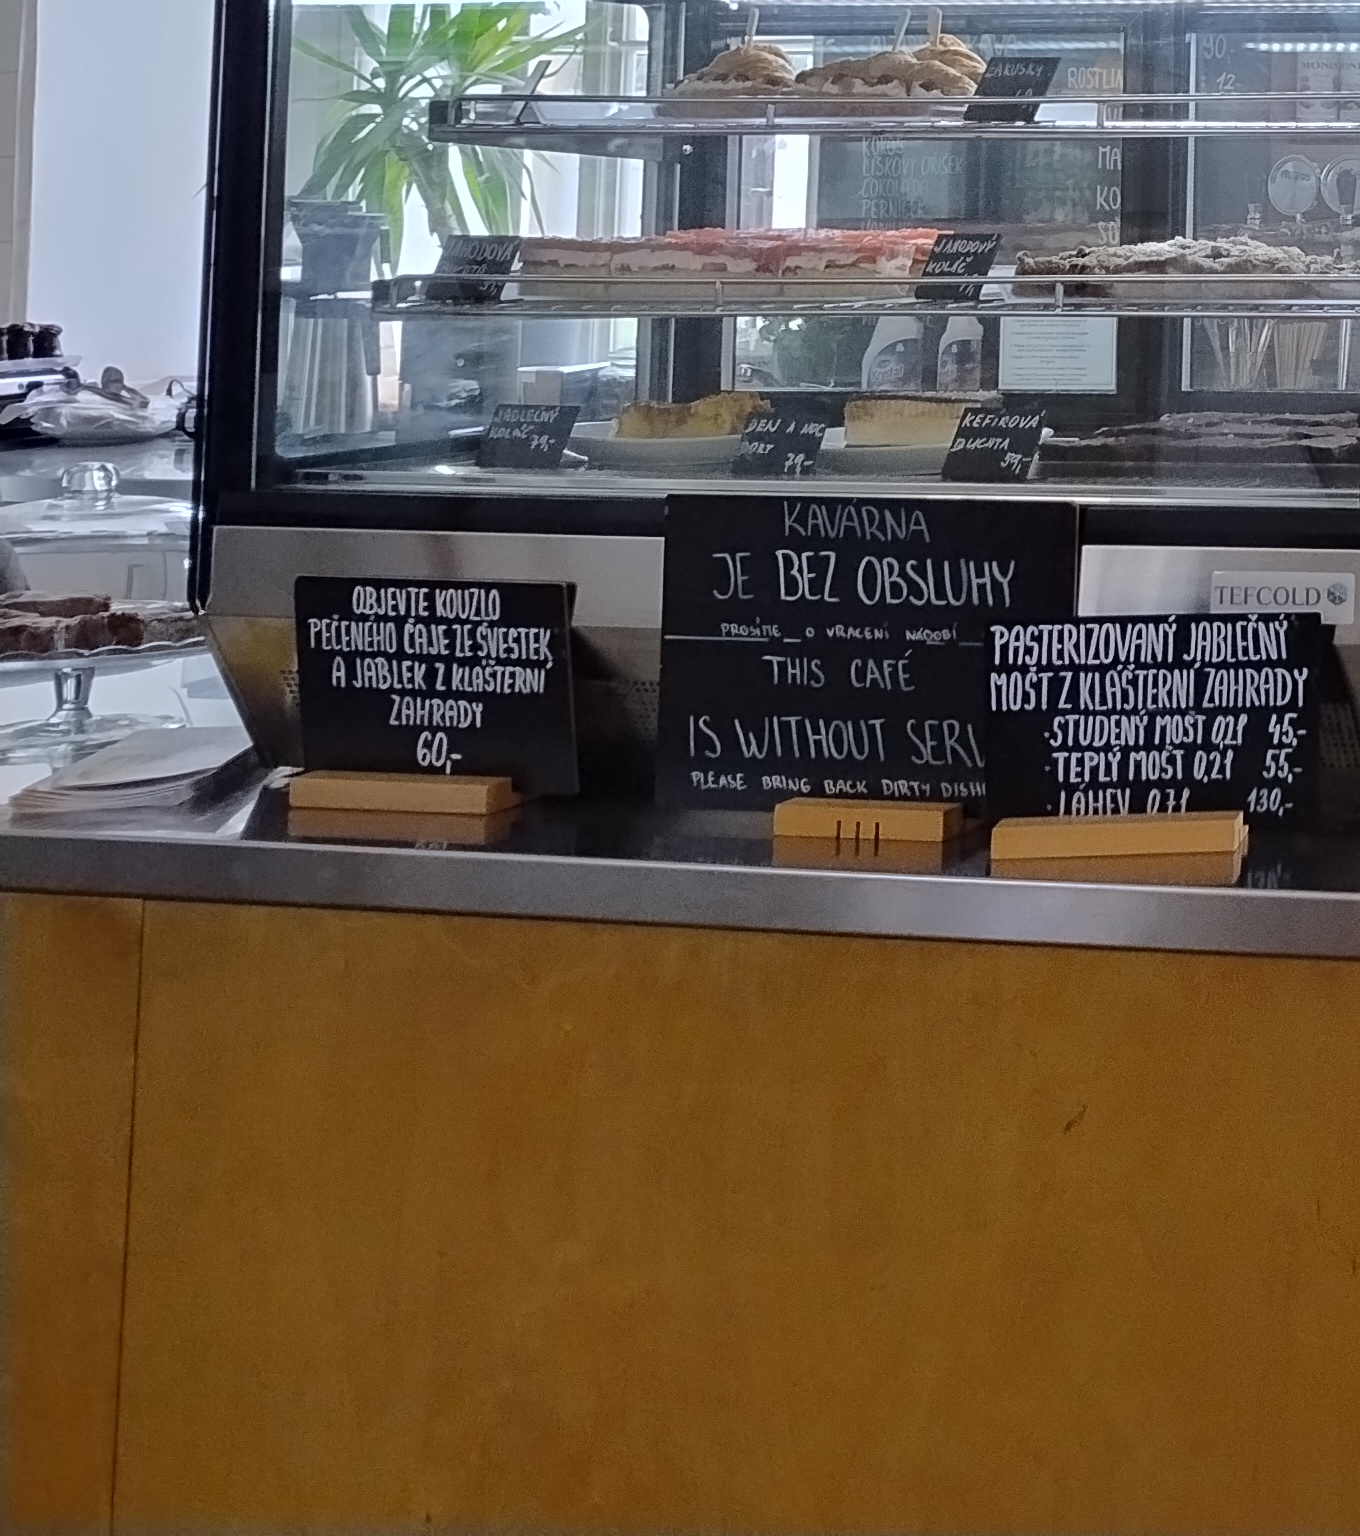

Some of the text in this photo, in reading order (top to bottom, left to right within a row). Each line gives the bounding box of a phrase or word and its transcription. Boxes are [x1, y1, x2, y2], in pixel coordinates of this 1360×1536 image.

[783, 498, 931, 542] KAVÁRNA
[713, 549, 1015, 607] JE BEZ OBSLUHY
[1215, 586, 1322, 606] TEFCOLD
[353, 586, 500, 620] OBJEVTE KOUZLO
[308, 615, 474, 657] PEČENÉHO ČAJE ZE
[806, 627, 814, 638] O
[990, 614, 1288, 665] PASTERIZOVANÝ JABLEČNÝ
[332, 656, 446, 690] A JABLEK Z
[763, 650, 915, 691] THIS CAFÉ
[990, 661, 1308, 711] MOŠT Z KLÁŠTERNÍ ZAHRADY
[389, 695, 483, 728] ZAHRADY
[1156, 710, 1205, 745] MOŠT
[417, 731, 462, 774] 60,-
[690, 715, 885, 762] IS WITHOUT
[1129, 746, 1184, 781] MOŠT
[691, 771, 930, 797] PLEASE BRING BACK DIRTY
